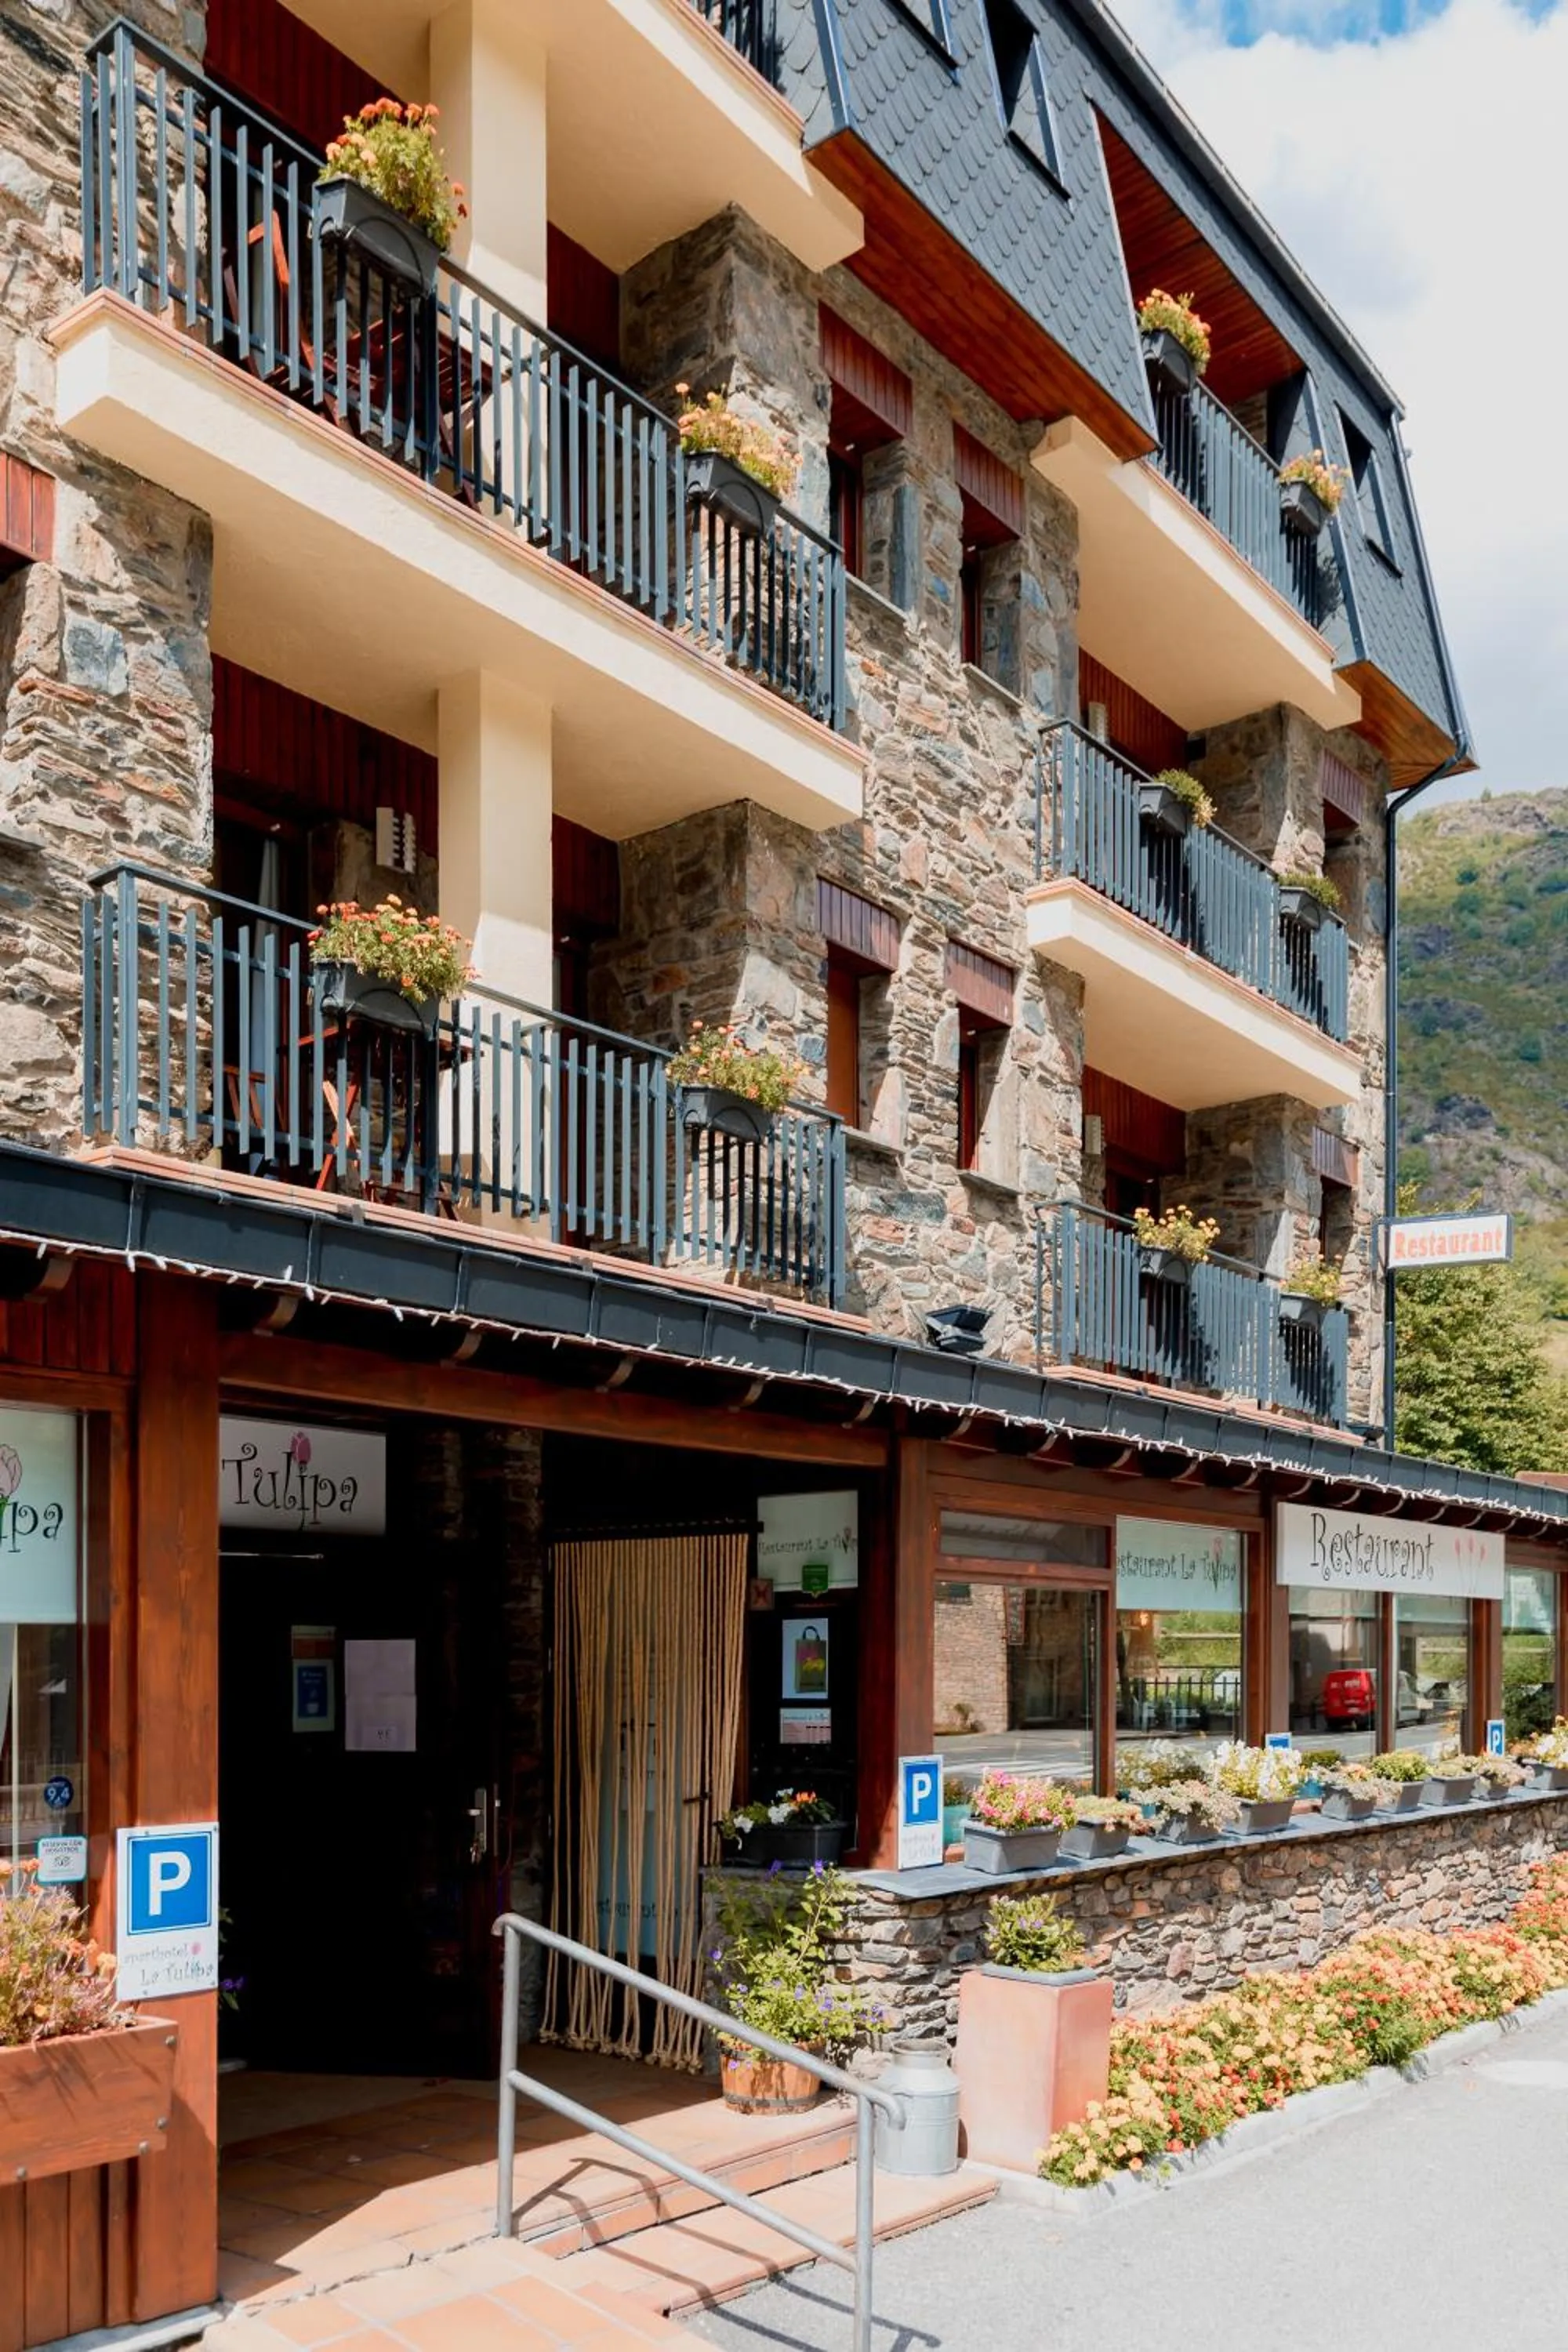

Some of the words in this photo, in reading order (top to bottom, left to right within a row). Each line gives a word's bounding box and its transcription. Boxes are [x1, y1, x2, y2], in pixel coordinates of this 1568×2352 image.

[1395, 1228, 1503, 1261] Restaurant
[222, 1443, 358, 1525] Tulipa
[1310, 1512, 1434, 1581] Restaurant
[1493, 1730, 1501, 1754] P
[913, 1772, 932, 1815] P
[148, 1851, 191, 1915] P
